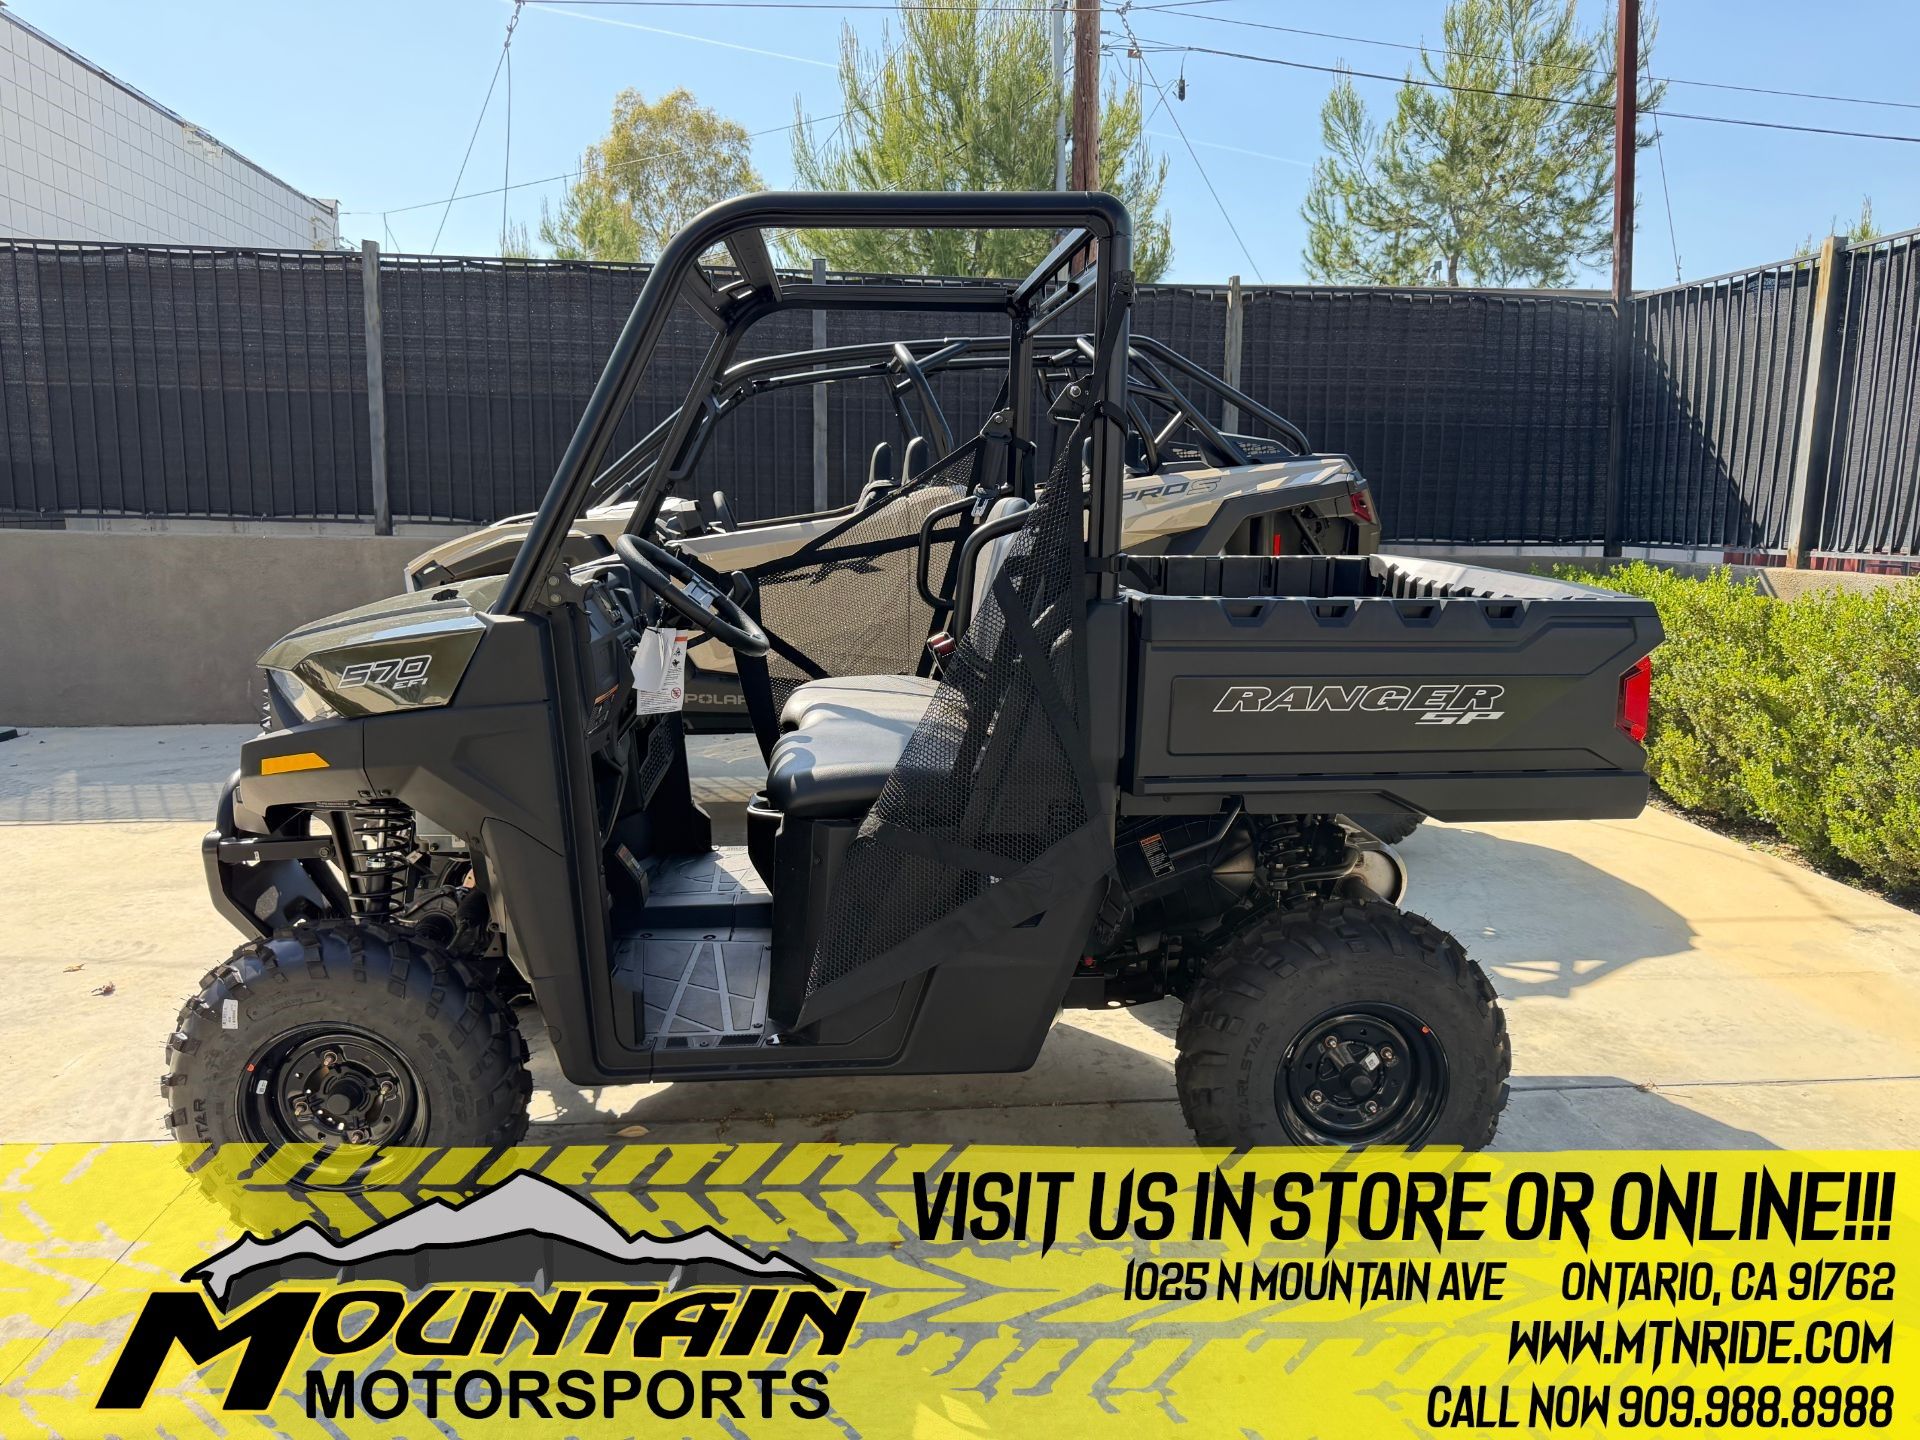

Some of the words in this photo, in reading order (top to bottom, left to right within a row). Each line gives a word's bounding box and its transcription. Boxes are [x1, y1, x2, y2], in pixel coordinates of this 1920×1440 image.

[337, 655, 432, 689] 570
[392, 677, 428, 690] EFI
[1212, 684, 1505, 712] RANGER
[1414, 711, 1505, 725] SP
